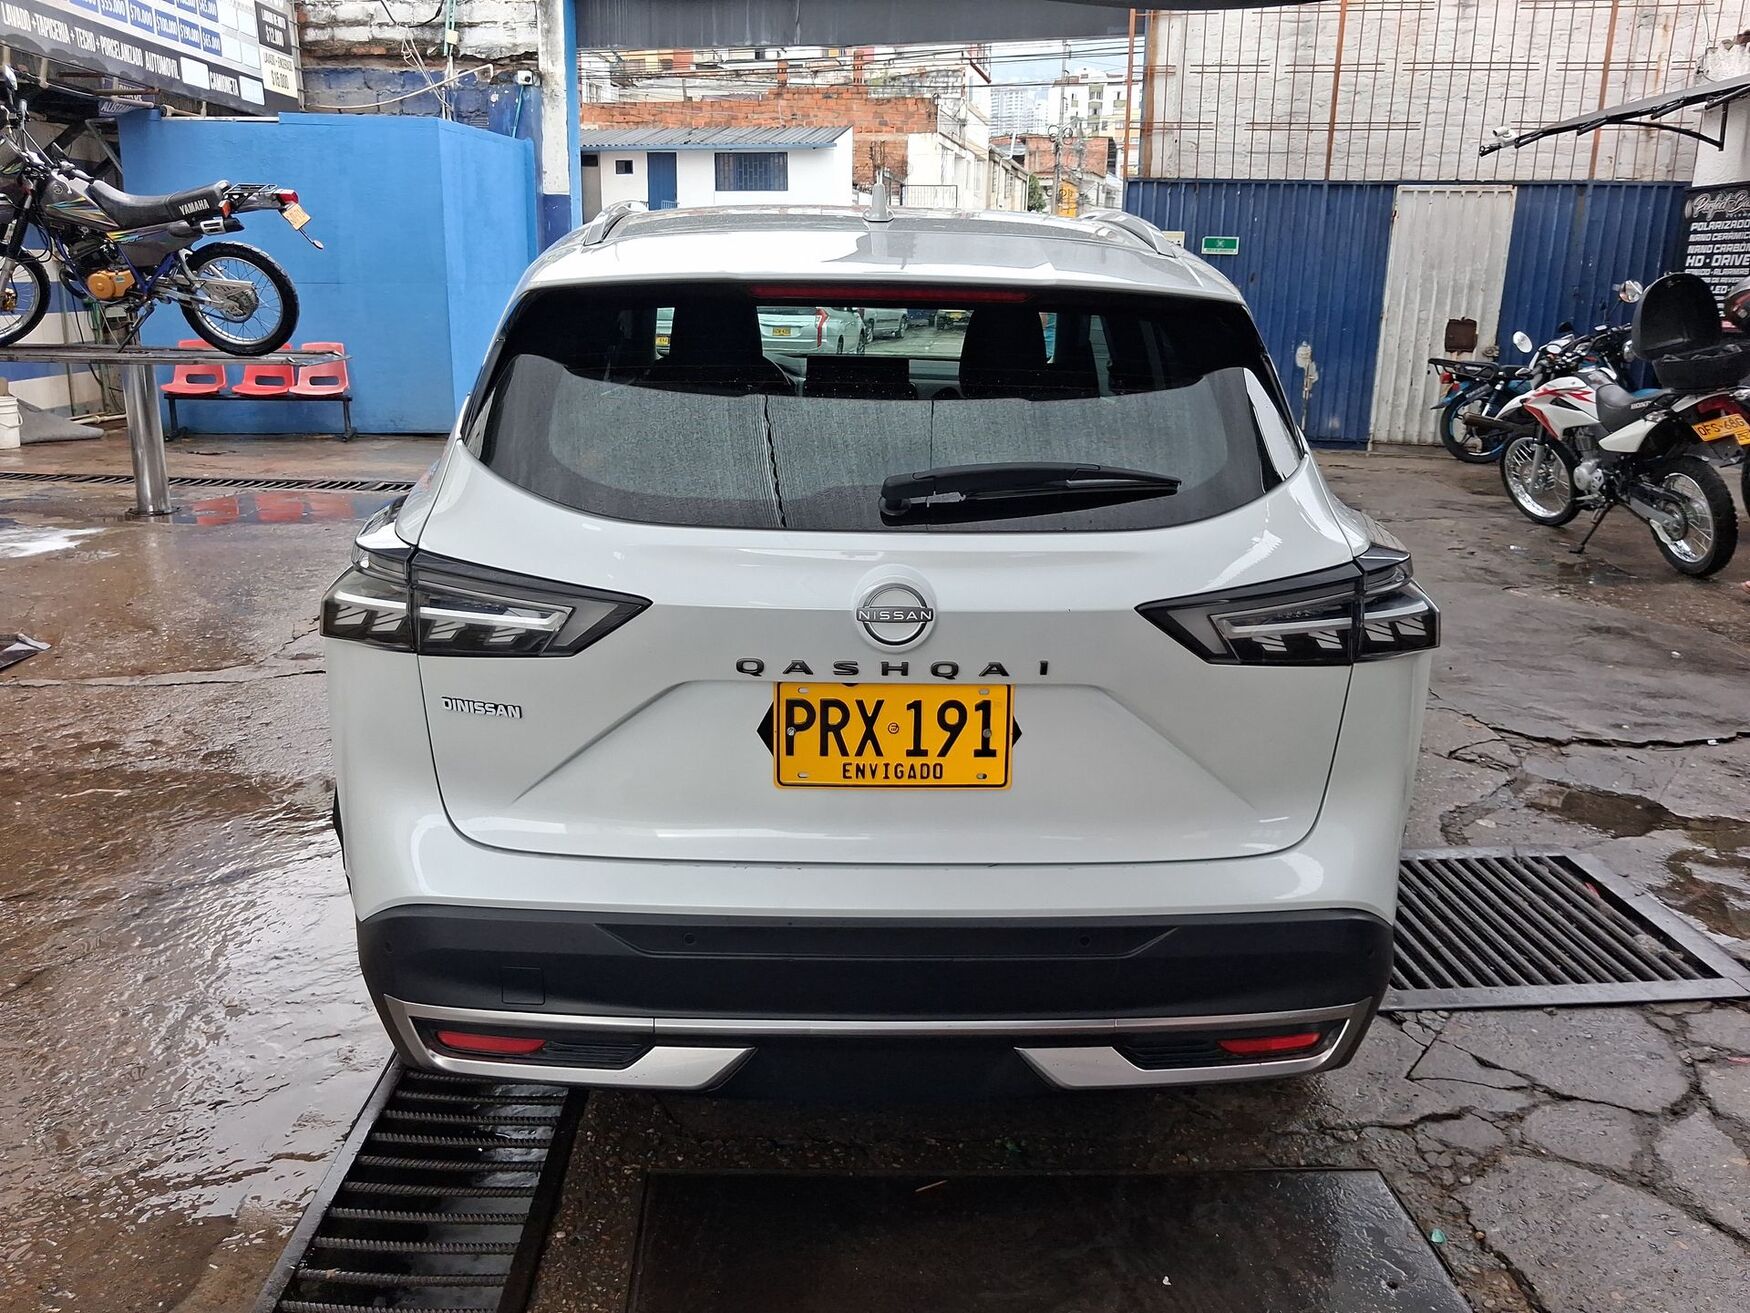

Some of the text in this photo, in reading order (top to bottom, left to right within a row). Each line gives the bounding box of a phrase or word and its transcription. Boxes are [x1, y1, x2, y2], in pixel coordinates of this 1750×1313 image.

[0, 1, 31, 32] LAVADO
[179, 199, 210, 216] YAMAHA
[1711, 254, 1750, 266] DRIVE
[858, 608, 933, 622] NISSAN
[735, 657, 1050, 681] QASHQAI
[441, 696, 523, 719] DINISSAN
[785, 698, 997, 759] PRX 191
[842, 762, 944, 780] ENVIGADO
